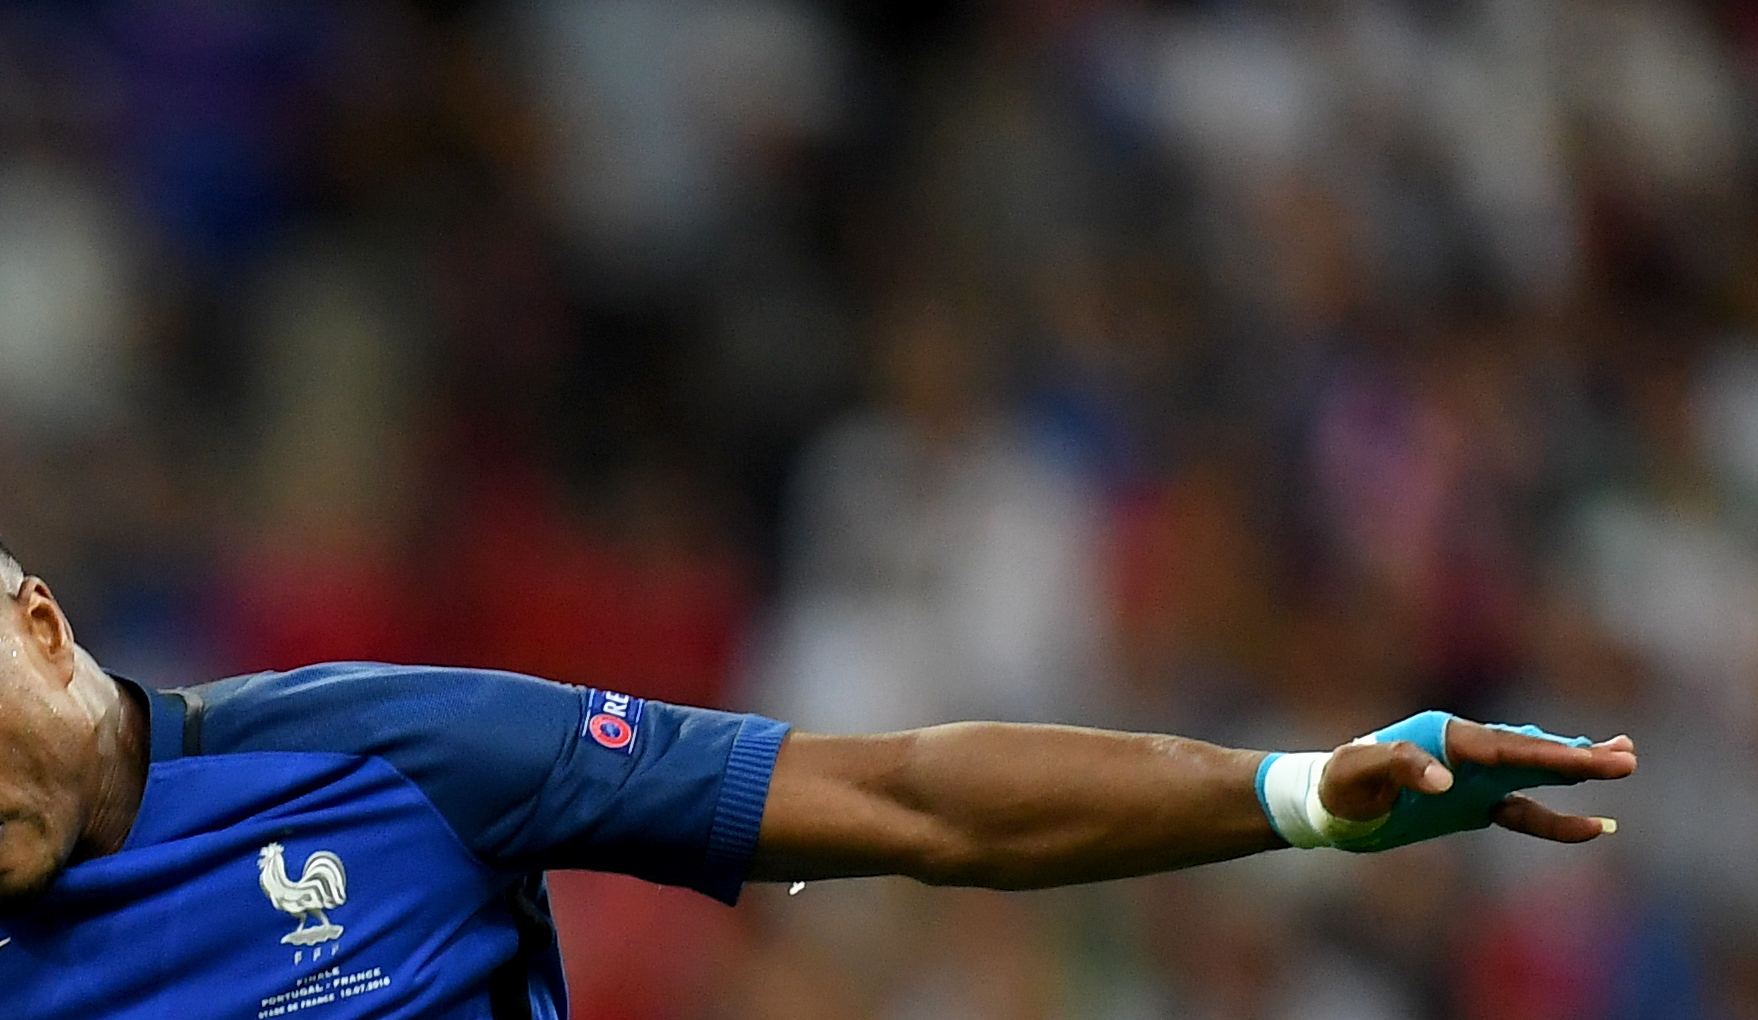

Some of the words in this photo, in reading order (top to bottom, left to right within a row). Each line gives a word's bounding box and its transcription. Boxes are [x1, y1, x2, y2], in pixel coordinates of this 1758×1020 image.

[262, 983, 323, 1008] PORTUGAL
[333, 967, 381, 988] FRANCE
[297, 966, 340, 986] FINALE
